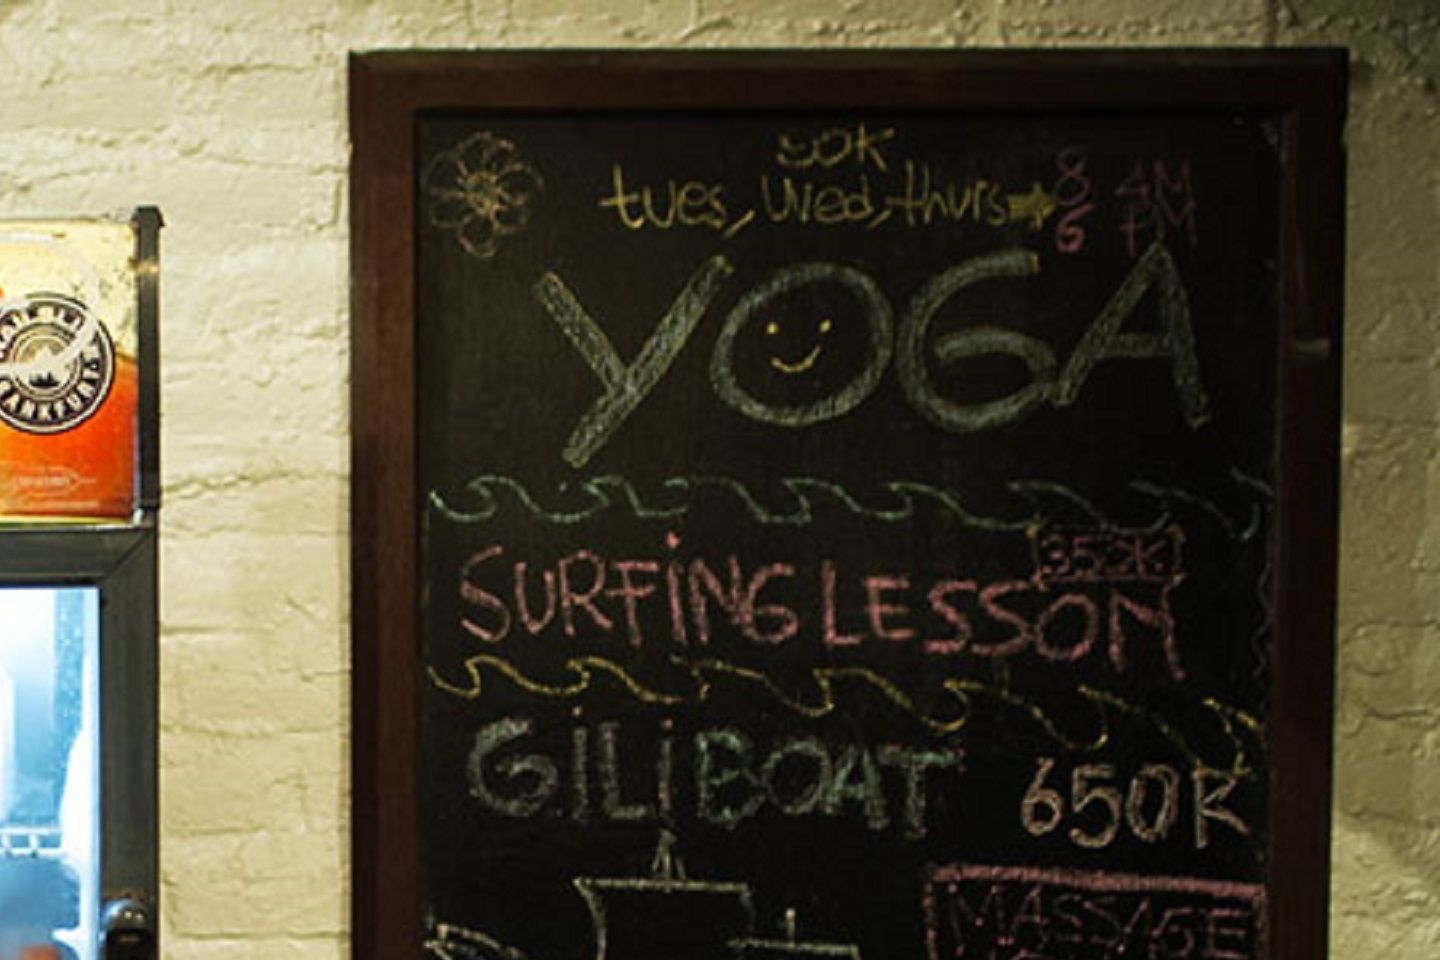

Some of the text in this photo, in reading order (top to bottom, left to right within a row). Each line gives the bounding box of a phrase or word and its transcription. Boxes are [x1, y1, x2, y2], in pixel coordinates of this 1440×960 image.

[534, 243, 1212, 468] YOGA
[820, 558, 1188, 682] LESSON
[1019, 755, 1253, 852] 650K
